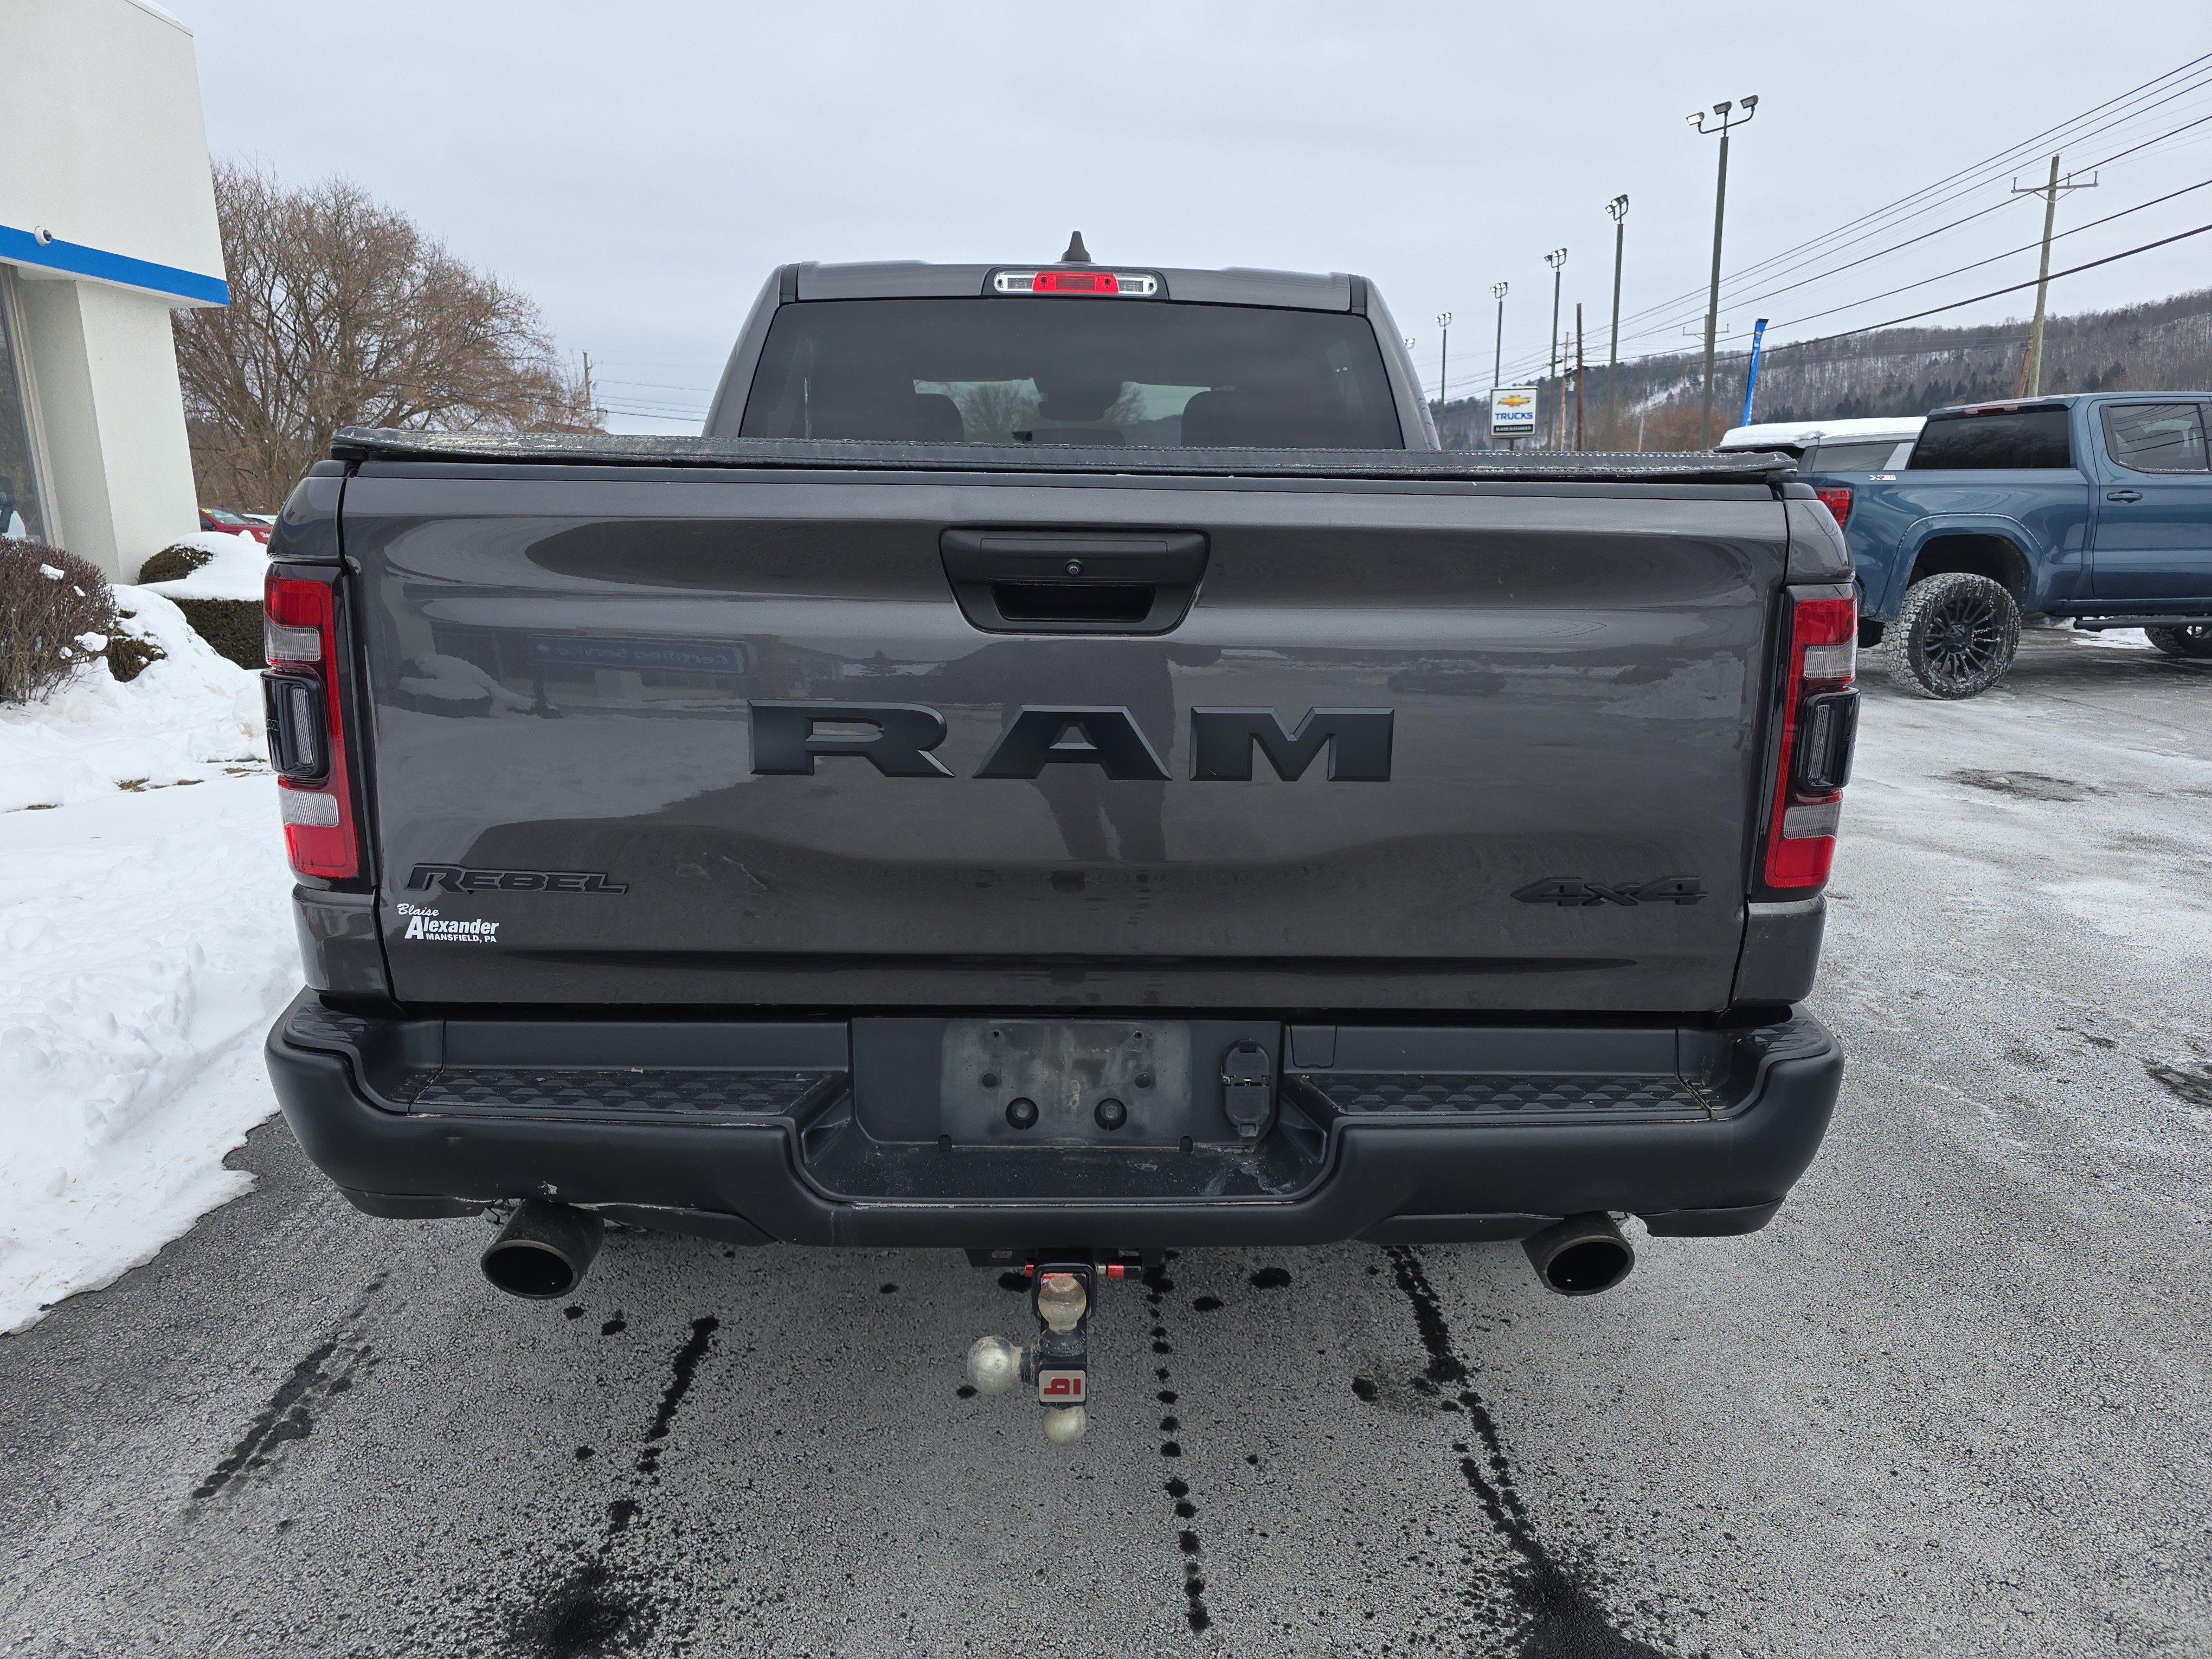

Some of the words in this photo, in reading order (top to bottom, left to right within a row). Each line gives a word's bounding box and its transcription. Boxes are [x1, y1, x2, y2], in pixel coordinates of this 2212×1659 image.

[1495, 411, 1533, 421] TRUCKS
[748, 699, 1394, 782] RAM
[404, 863, 629, 895] REBEL
[397, 903, 440, 917] Blaise
[404, 916, 499, 940] Alexander
[426, 933, 483, 944] MANSFIELD,
